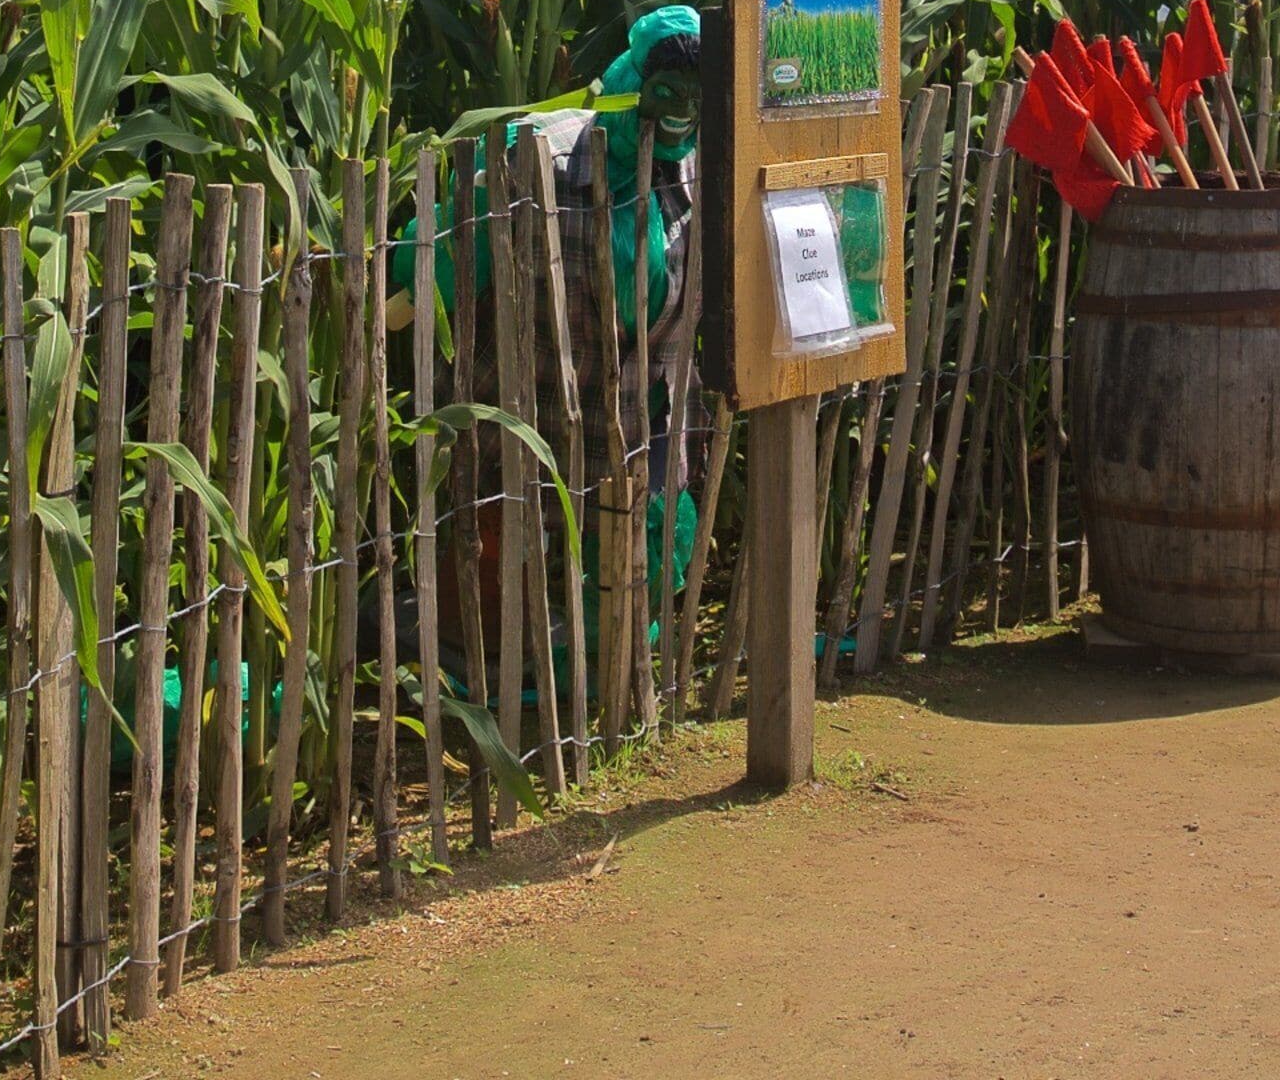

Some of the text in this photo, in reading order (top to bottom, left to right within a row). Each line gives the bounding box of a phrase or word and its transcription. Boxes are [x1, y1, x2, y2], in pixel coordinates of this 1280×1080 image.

[796, 227, 816, 238] Maze
[802, 248, 818, 260] Clue
[795, 268, 829, 283] Locations
